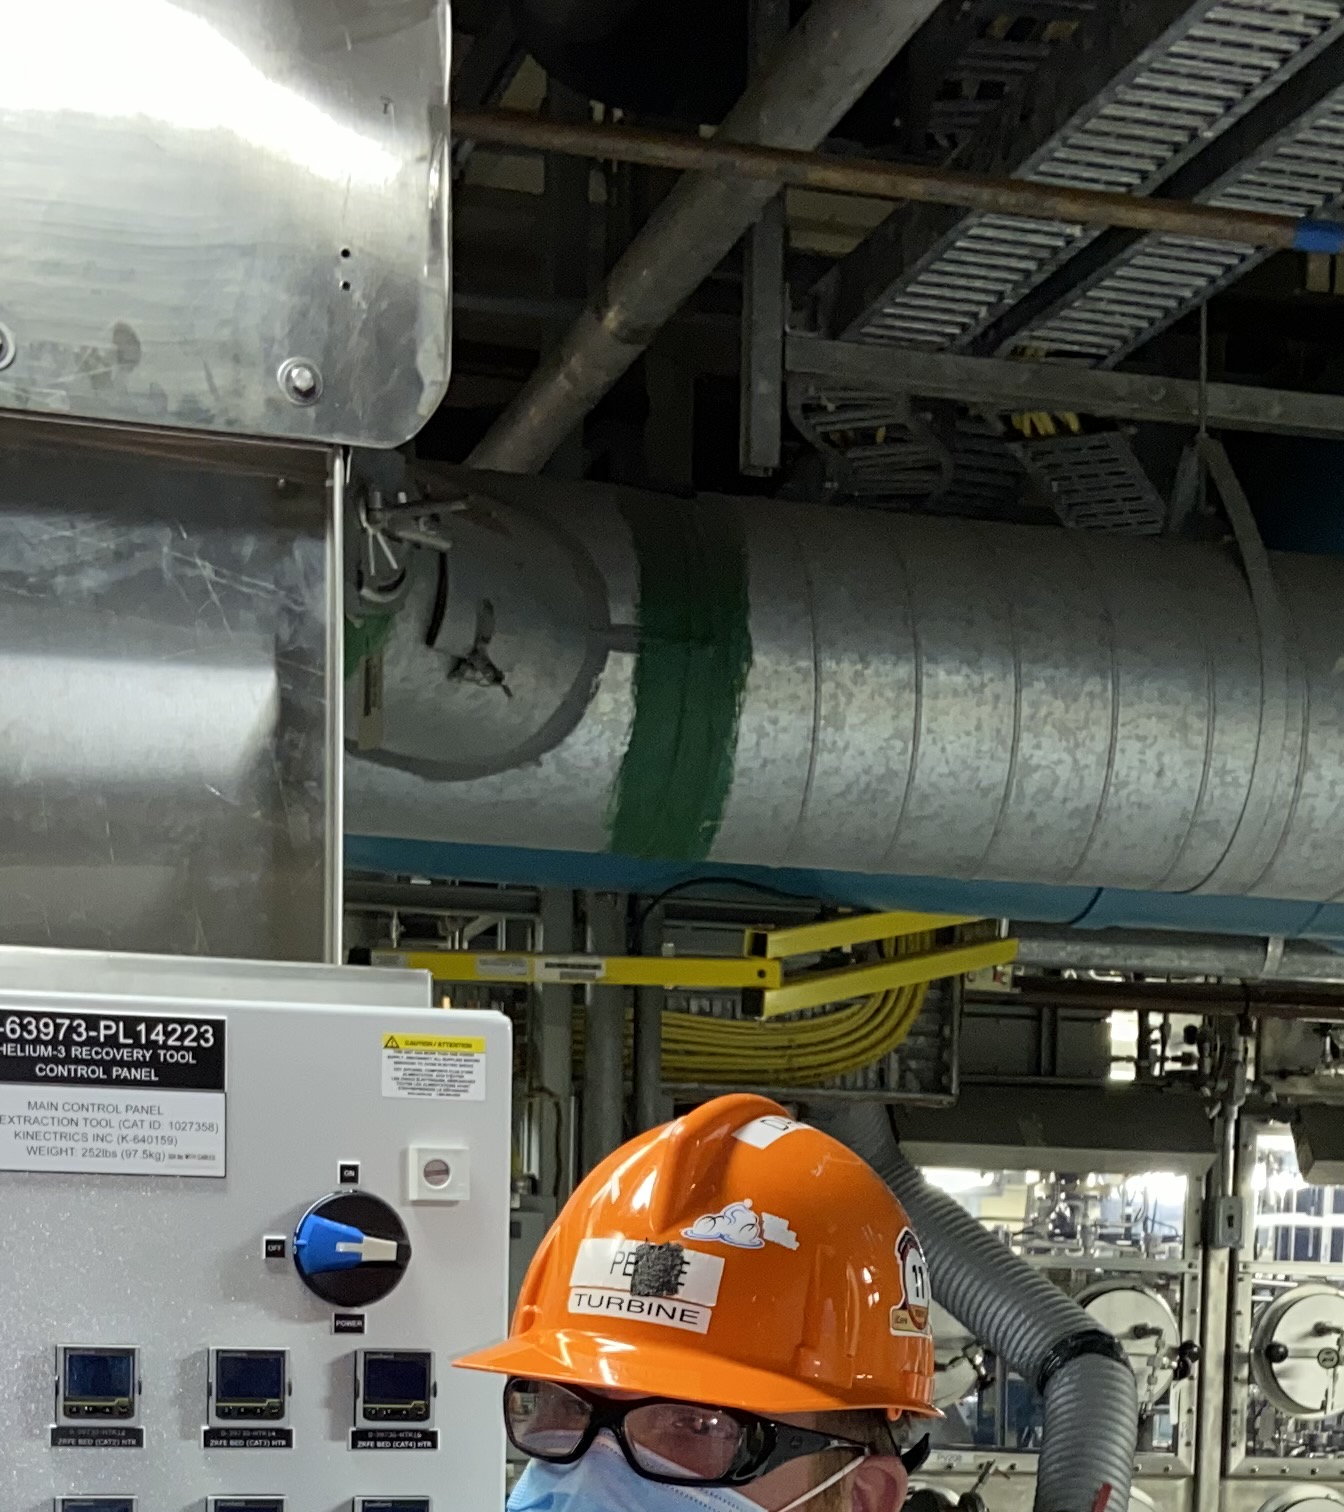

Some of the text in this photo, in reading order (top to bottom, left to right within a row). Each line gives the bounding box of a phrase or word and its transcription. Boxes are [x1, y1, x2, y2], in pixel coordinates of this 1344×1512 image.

[71, 1046, 152, 1062] RECOVERY
[158, 1049, 197, 1064] TOOL
[35, 1063, 159, 1081] CONTROL PANEL
[27, 1101, 164, 1116] MAIN CONTROL PANEL
[0, 1115, 79, 1128] EXTRACTION
[83, 1117, 115, 1129] TOOL
[118, 1119, 145, 1131] (CAT
[168, 1121, 219, 1134] 1027358)
[13, 1130, 178, 1148] KINECTRICS INC (K-640159)
[574, 1293, 700, 1325] TURBINE
[78, 1438, 93, 1446] BED
[121, 1438, 136, 1446] HTR
[229, 1438, 244, 1447] BED
[271, 1439, 287, 1447] HTR
